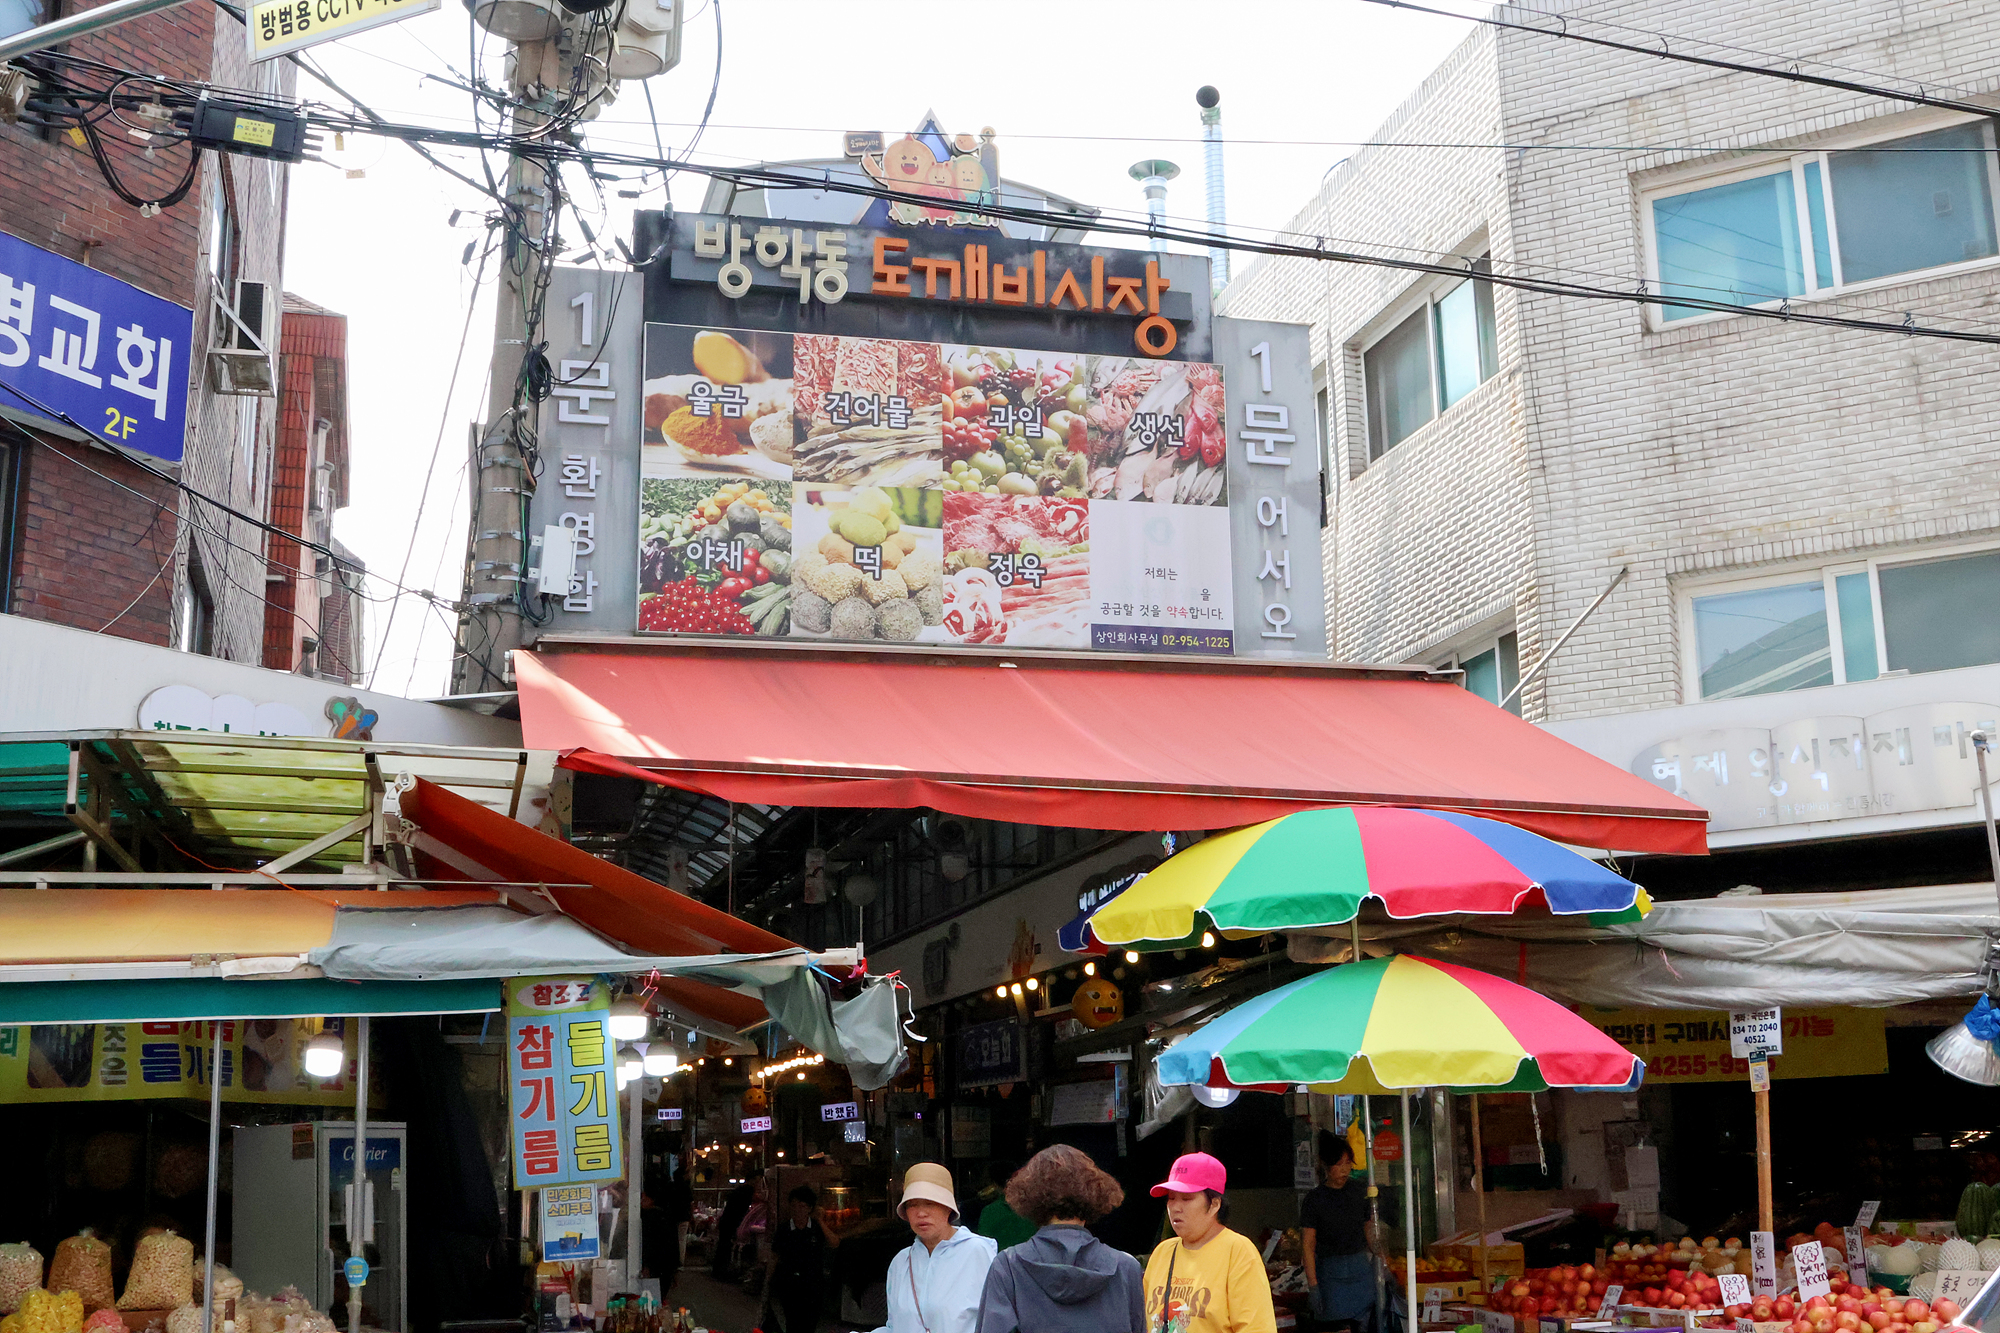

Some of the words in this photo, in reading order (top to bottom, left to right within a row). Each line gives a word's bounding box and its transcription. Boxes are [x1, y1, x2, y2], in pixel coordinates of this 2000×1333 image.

[261, 0, 311, 41] 방범용
[695, 221, 848, 304] 방학동
[871, 236, 1178, 357] 도깨비시장
[687, 382, 748, 418] 울금
[825, 391, 913, 430] 건어물
[104, 407, 138, 440] 2F
[987, 404, 1044, 438] 과일
[1130, 412, 1186, 448] 생선
[686, 538, 744, 573] 야채
[853, 544, 882, 580] 떡
[987, 553, 1047, 589] 정육
[1145, 567, 1178, 580] 저희는
[1100, 602, 1134, 616] 공급할
[1139, 604, 1161, 618] 것을
[1166, 605, 1224, 620] 약속합니다.
[1200, 588, 1211, 602] 을
[1096, 631, 1158, 646] 상인회사무실
[1162, 634, 1230, 648] 02-954-1225
[1749, 727, 1914, 797] 왕식자재
[1732, 1025, 1745, 1035] 834
[1748, 1025, 1757, 1033] 70
[1759, 1022, 1778, 1032] 2040
[1744, 1034, 1766, 1044] 40522
[516, 1024, 560, 1176] 참기름
[567, 1020, 613, 1172] 들기름
[824, 1105, 855, 1120] 반했닭
[547, 1186, 592, 1203] 민생회복
[547, 1201, 592, 1217] 소비쿠폰
